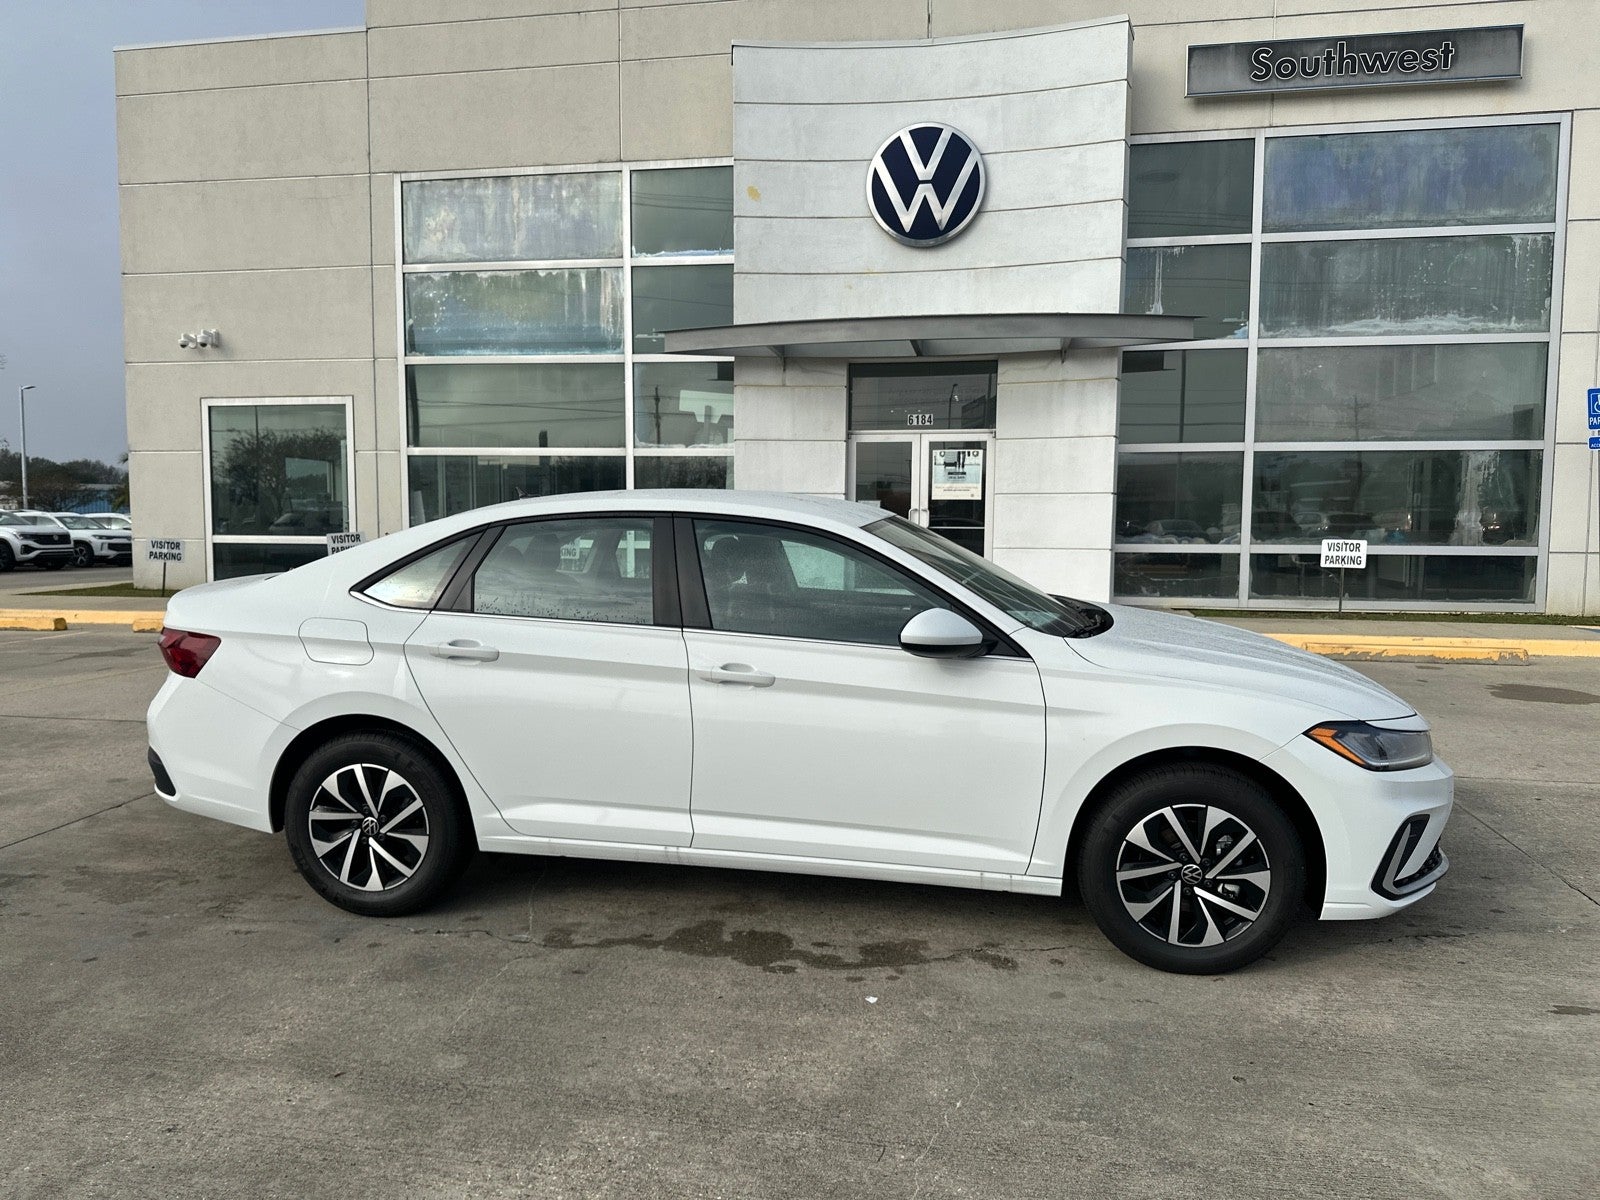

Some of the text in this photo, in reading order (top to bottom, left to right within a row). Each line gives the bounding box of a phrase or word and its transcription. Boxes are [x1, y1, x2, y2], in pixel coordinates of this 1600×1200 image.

[1250, 41, 1455, 82] Southwest
[871, 126, 981, 234] VW
[908, 414, 932, 425] 6184
[330, 533, 361, 544] VISITOR
[151, 540, 181, 550] VISITOR
[1327, 542, 1361, 552] VISITOR
[149, 550, 182, 561] PARKING
[1324, 555, 1362, 566] PARKING
